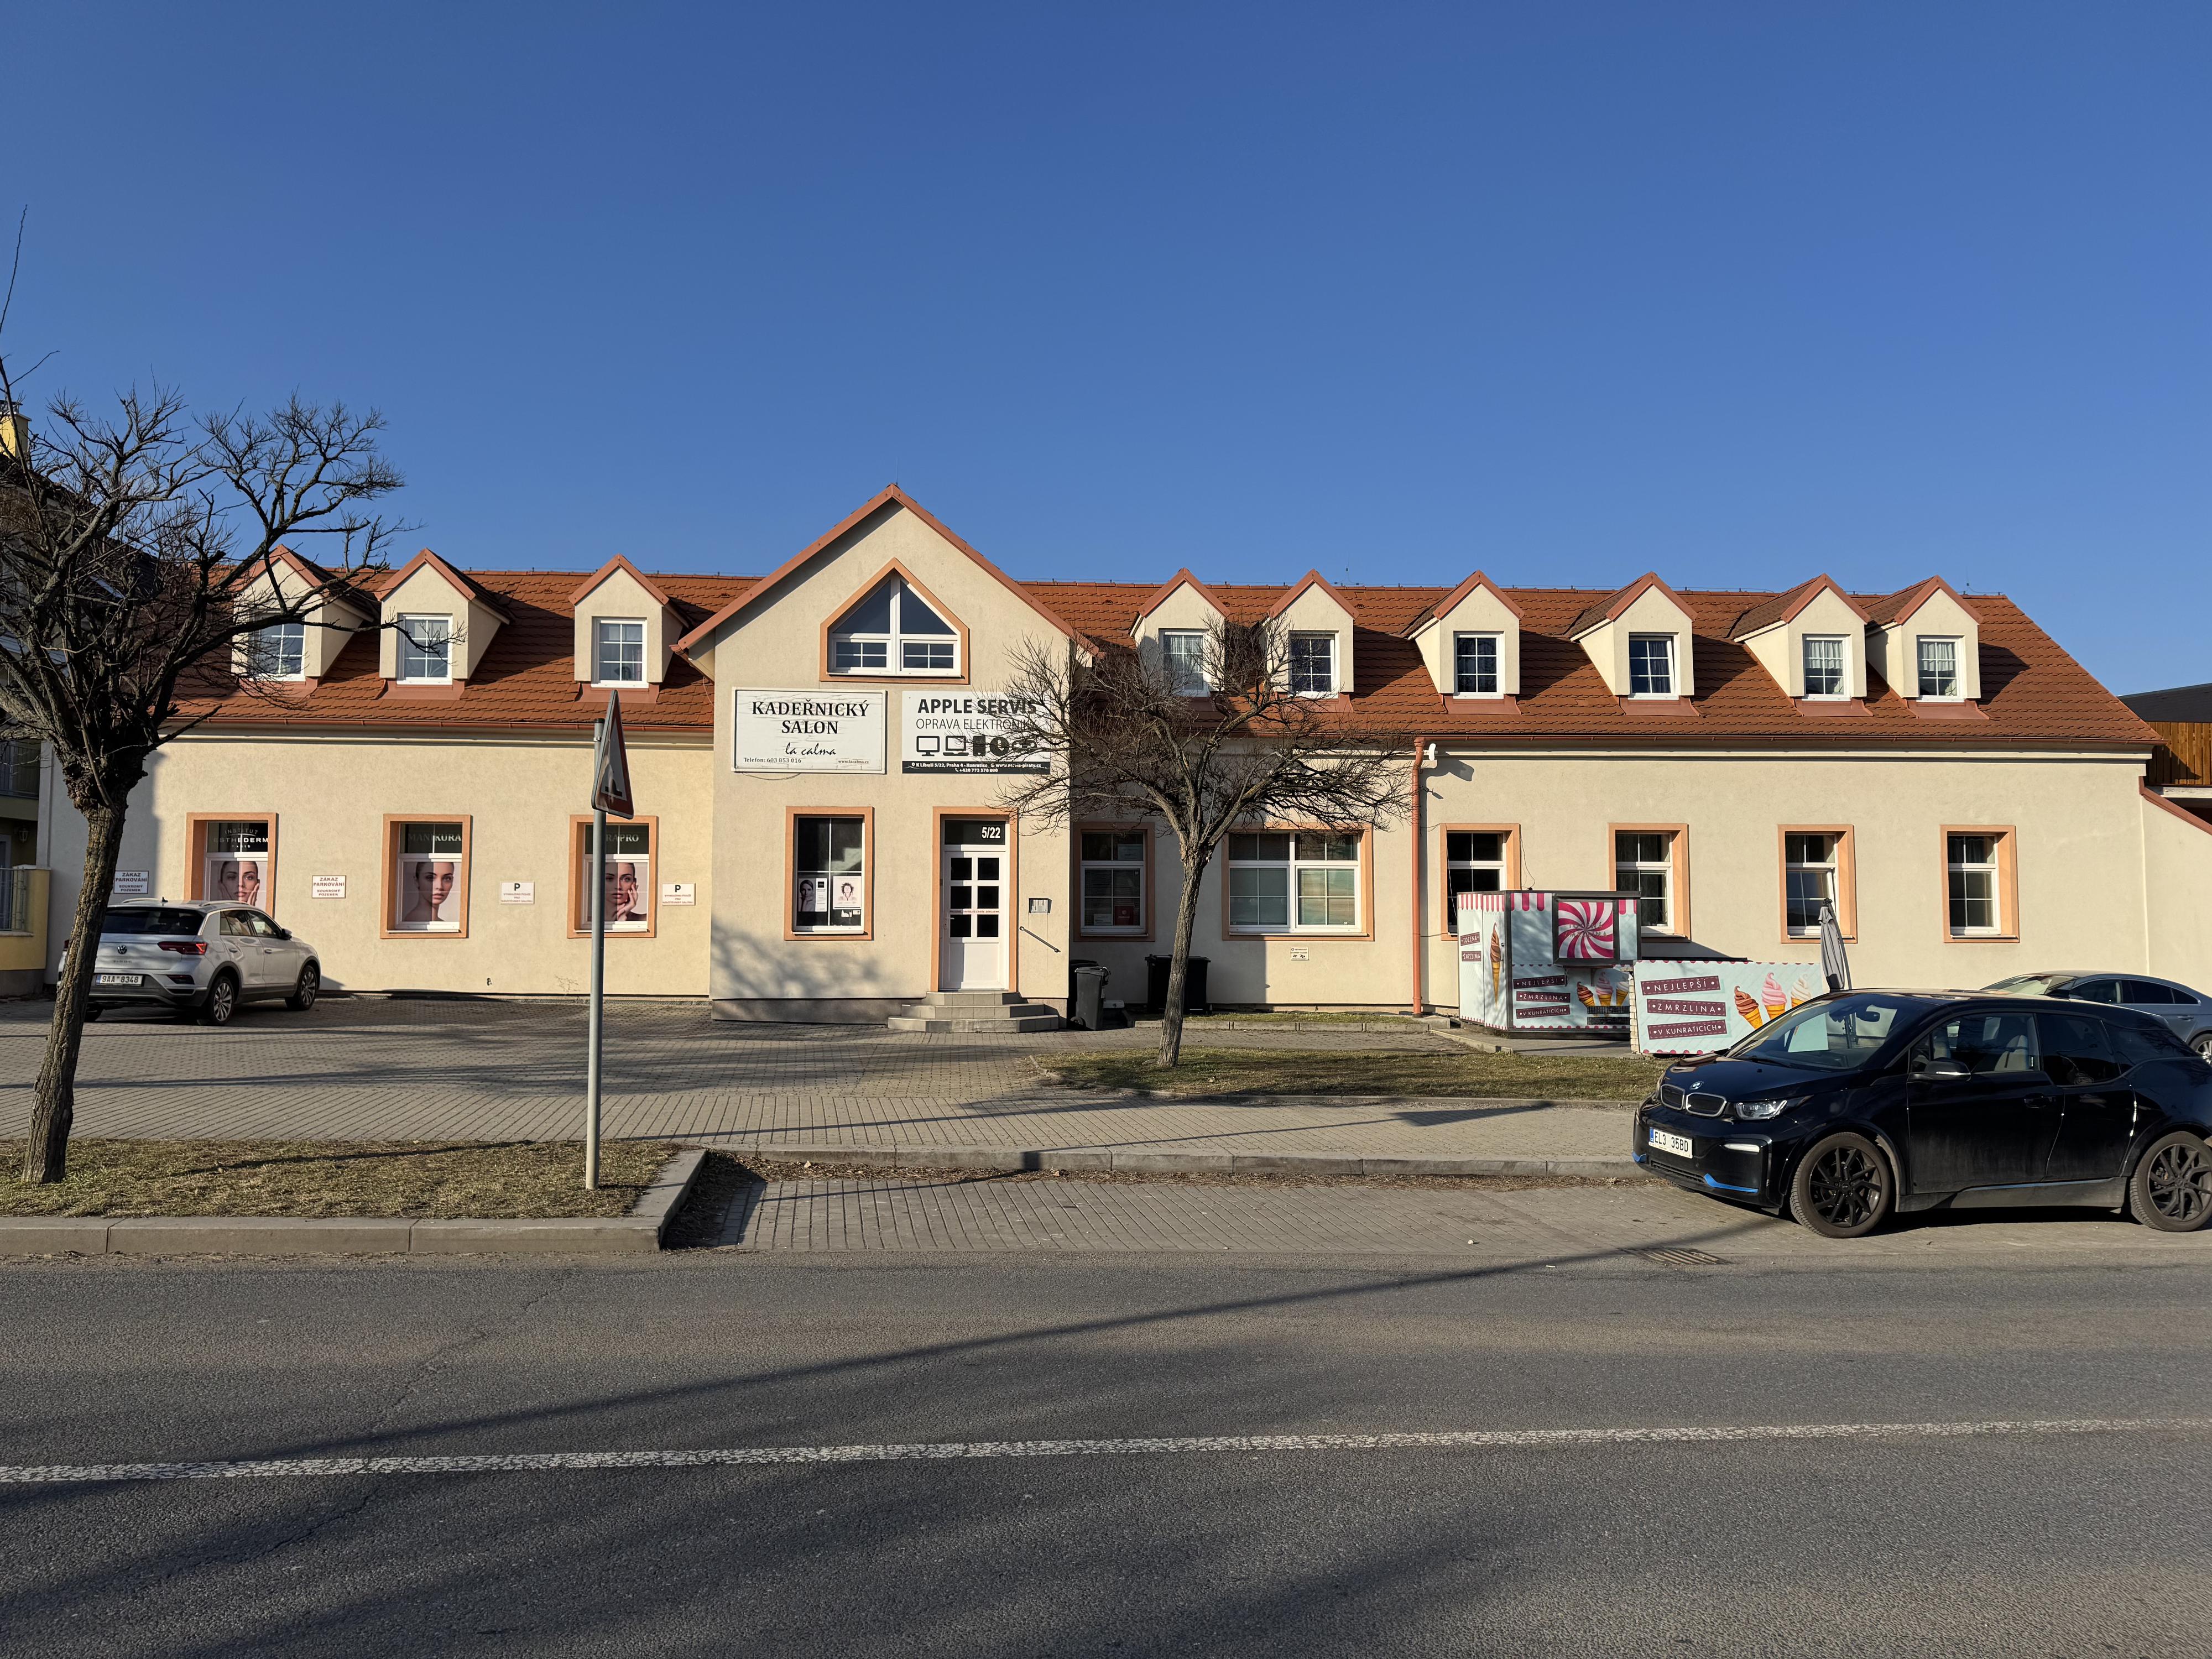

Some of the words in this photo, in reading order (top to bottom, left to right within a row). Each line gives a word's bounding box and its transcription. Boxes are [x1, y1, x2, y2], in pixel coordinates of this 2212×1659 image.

[752, 699, 870, 717] KADEŘNICKÝ
[917, 699, 973, 714] APPLE
[977, 699, 1037, 714] SERVIS
[781, 720, 839, 734] SALON
[916, 718, 960, 729] OPRAVA
[785, 742, 797, 755] la
[801, 743, 837, 755] calma
[982, 827, 1001, 839] 5/22
[514, 883, 521, 891] P
[675, 884, 681, 893] P
[1654, 978, 1707, 992] NEJLEPŠÍ
[1657, 1003, 1716, 1013] ZMRZLINA
[1666, 1024, 1717, 1035] KUNRATICÍCH
[1655, 1131, 1666, 1145] EL3
[1671, 1136, 1688, 1152] 35BD
